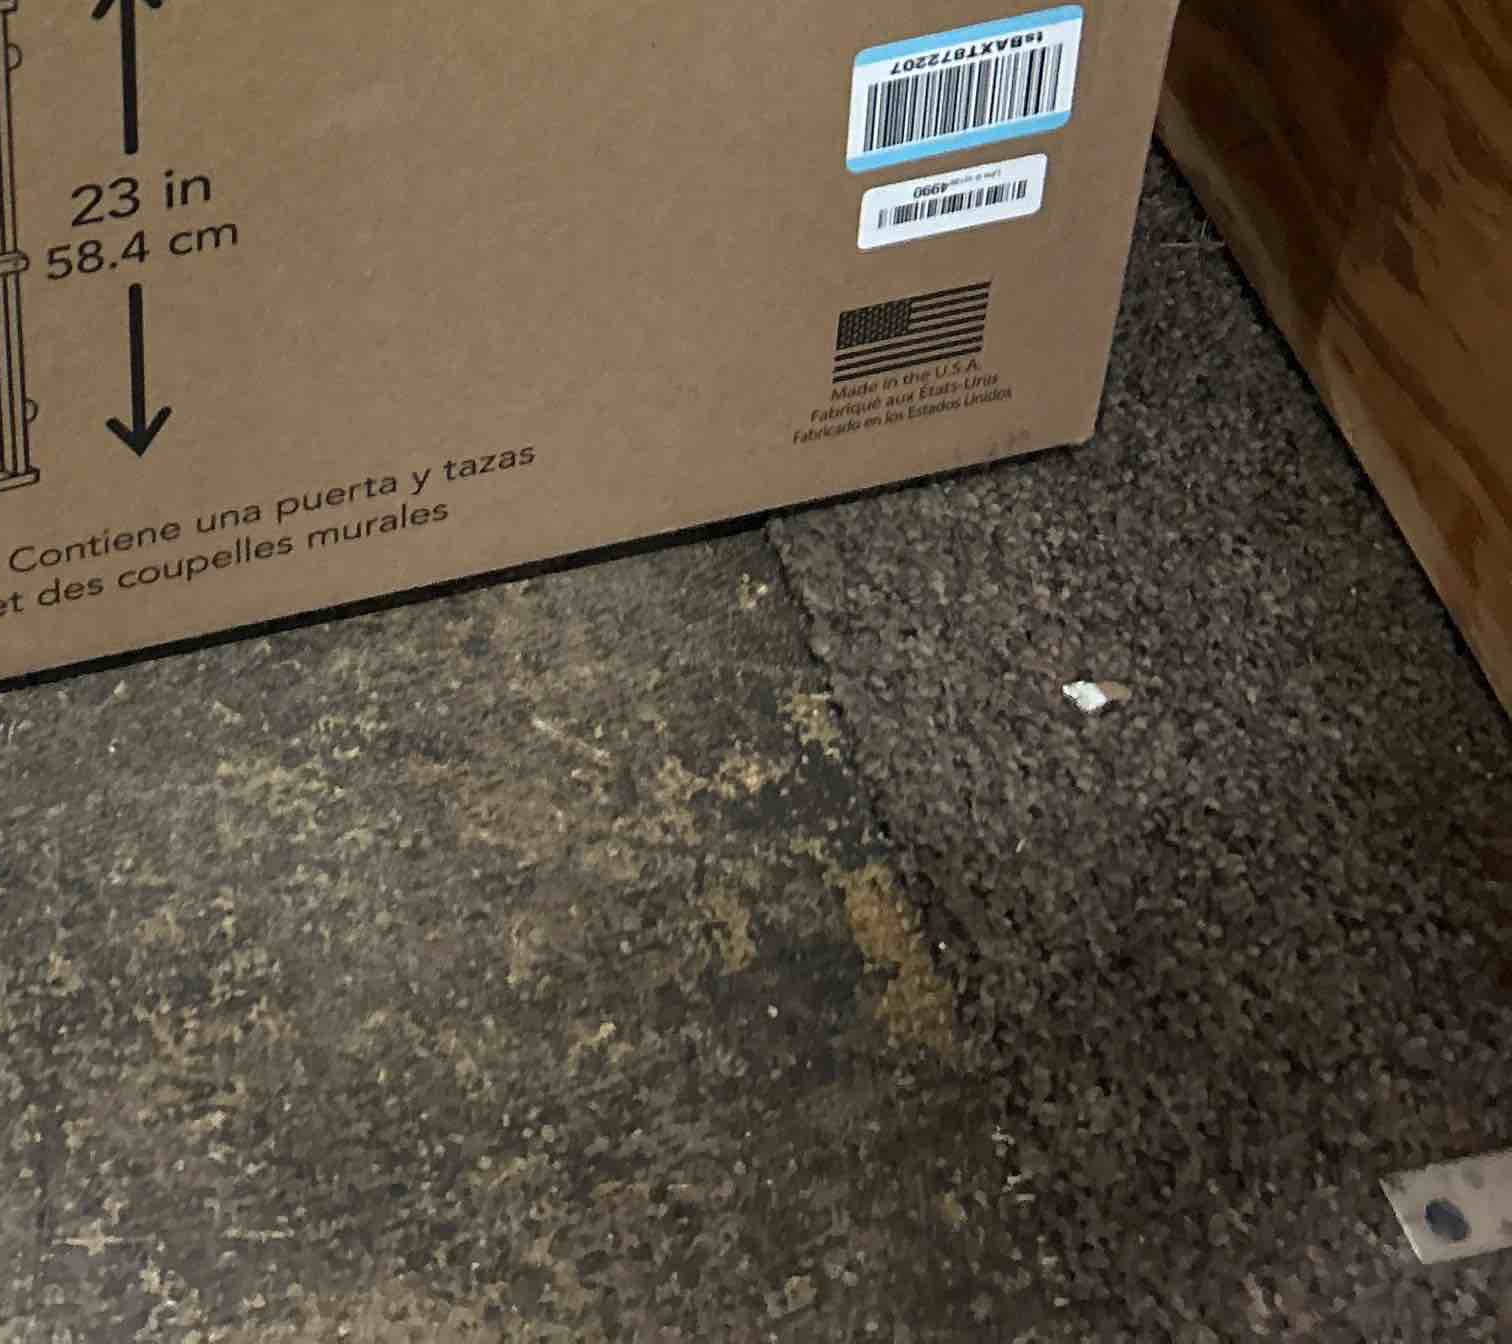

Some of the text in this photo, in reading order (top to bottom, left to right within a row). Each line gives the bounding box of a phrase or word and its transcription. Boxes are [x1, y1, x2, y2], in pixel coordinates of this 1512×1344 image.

[70, 169, 212, 227] 23 in
[46, 222, 239, 281] 58.4 cm
[8, 518, 182, 575] Contiene
[195, 502, 262, 536] una
[275, 471, 399, 524] puerta
[409, 465, 434, 495] y
[442, 443, 537, 482] tazas
[36, 572, 106, 609] des
[116, 533, 295, 591] coupelles
[307, 498, 450, 551] murales
